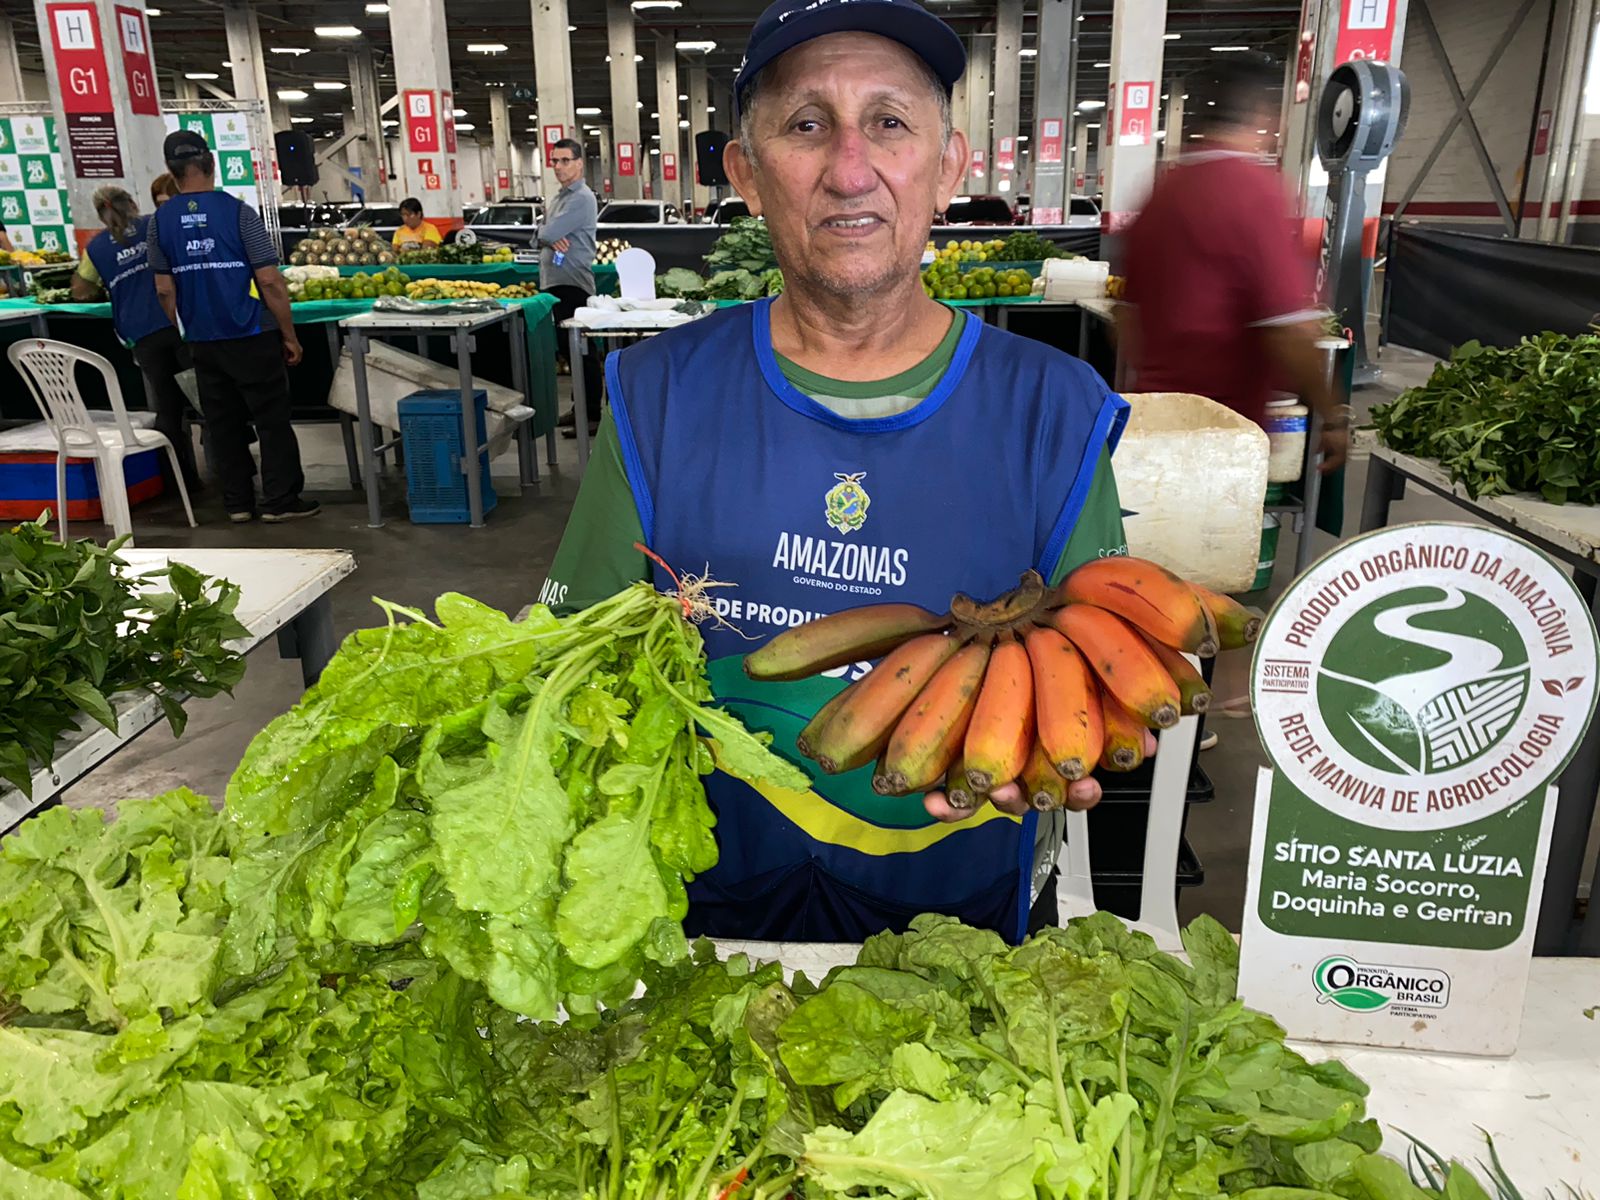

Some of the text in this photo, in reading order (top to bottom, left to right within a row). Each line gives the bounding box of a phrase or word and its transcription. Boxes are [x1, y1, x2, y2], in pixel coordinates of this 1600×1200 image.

[66, 16, 84, 43] H
[126, 20, 139, 48] H
[69, 67, 98, 96] G1
[132, 70, 150, 97] G1
[415, 98, 426, 113] G
[1133, 89, 1144, 105] G
[415, 126, 431, 142] G1
[1128, 118, 1145, 135] G1
[772, 531, 909, 586] AMAZONAS
[793, 576, 882, 596] GOVERNO DO ESTADO
[716, 598, 829, 627] DE PRODU
[1285, 543, 1574, 658] PRODUTO ORGÂNICO DA AMAZÔNIA
[1262, 679, 1309, 689] PARTICIPATIVO
[1263, 665, 1309, 679] SISTEMA
[1279, 713, 1565, 813] REDE MANIVA DE AGROECOLOGIA
[1274, 838, 1524, 878] SÍTIO SANTA LUZIA
[1302, 868, 1480, 901] Maria Socorro,
[1272, 890, 1512, 926] Doquinha e Gerfran
[1327, 964, 1444, 993] ORGÂNICO
[1357, 967, 1388, 975] PRODUTO
[1396, 992, 1442, 1004] BRASIL
[1390, 1011, 1437, 1019] PARTICIPATIVO
